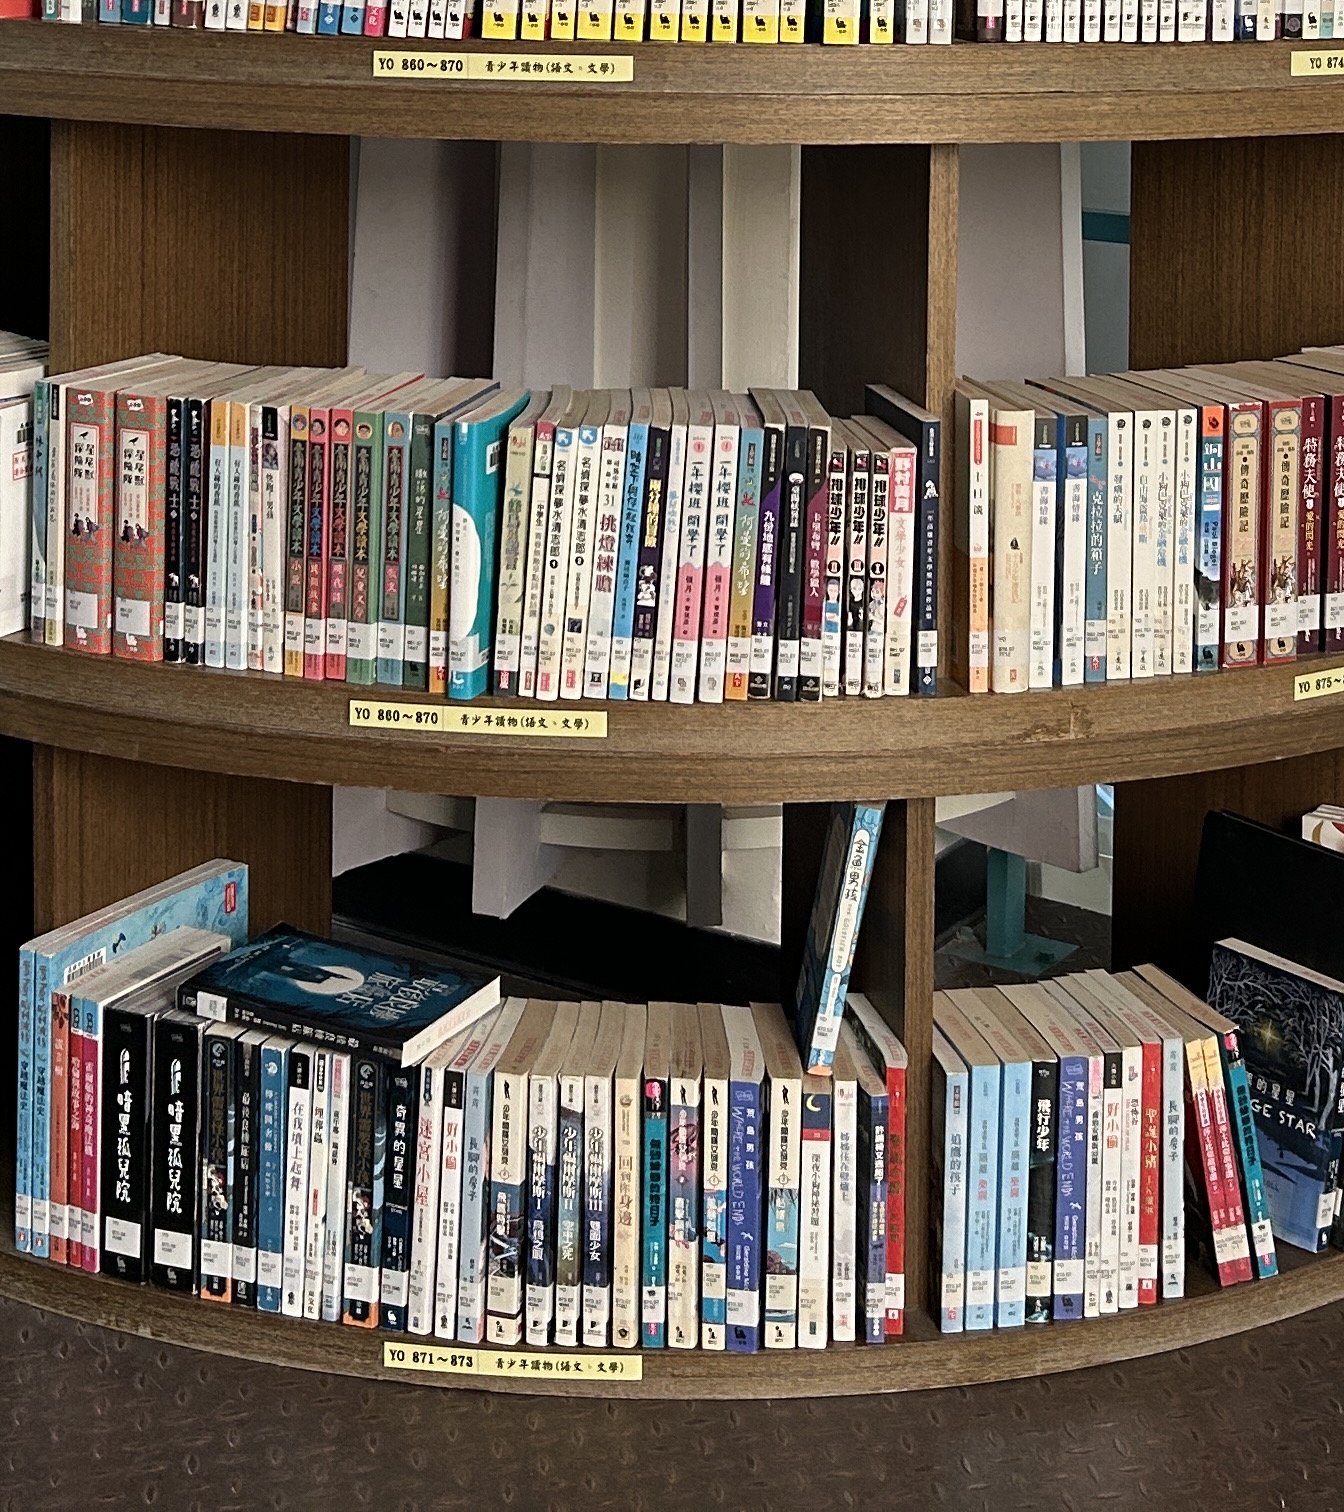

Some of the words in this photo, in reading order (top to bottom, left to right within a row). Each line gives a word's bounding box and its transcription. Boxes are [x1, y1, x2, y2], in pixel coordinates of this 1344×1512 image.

[378, 57, 395, 71] YO
[1309, 56, 1322, 69] YO
[1326, 55, 1344, 69] 874
[1090, 491, 1105, 576] 克拉拉的箱子
[1297, 680, 1311, 694] YO
[354, 707, 370, 720] YO
[1036, 1098, 1052, 1152] 飛行少年
[1278, 1109, 1317, 1140] STAR
[392, 1102, 408, 1190] 奇異的星星
[389, 1349, 406, 1362] YO
